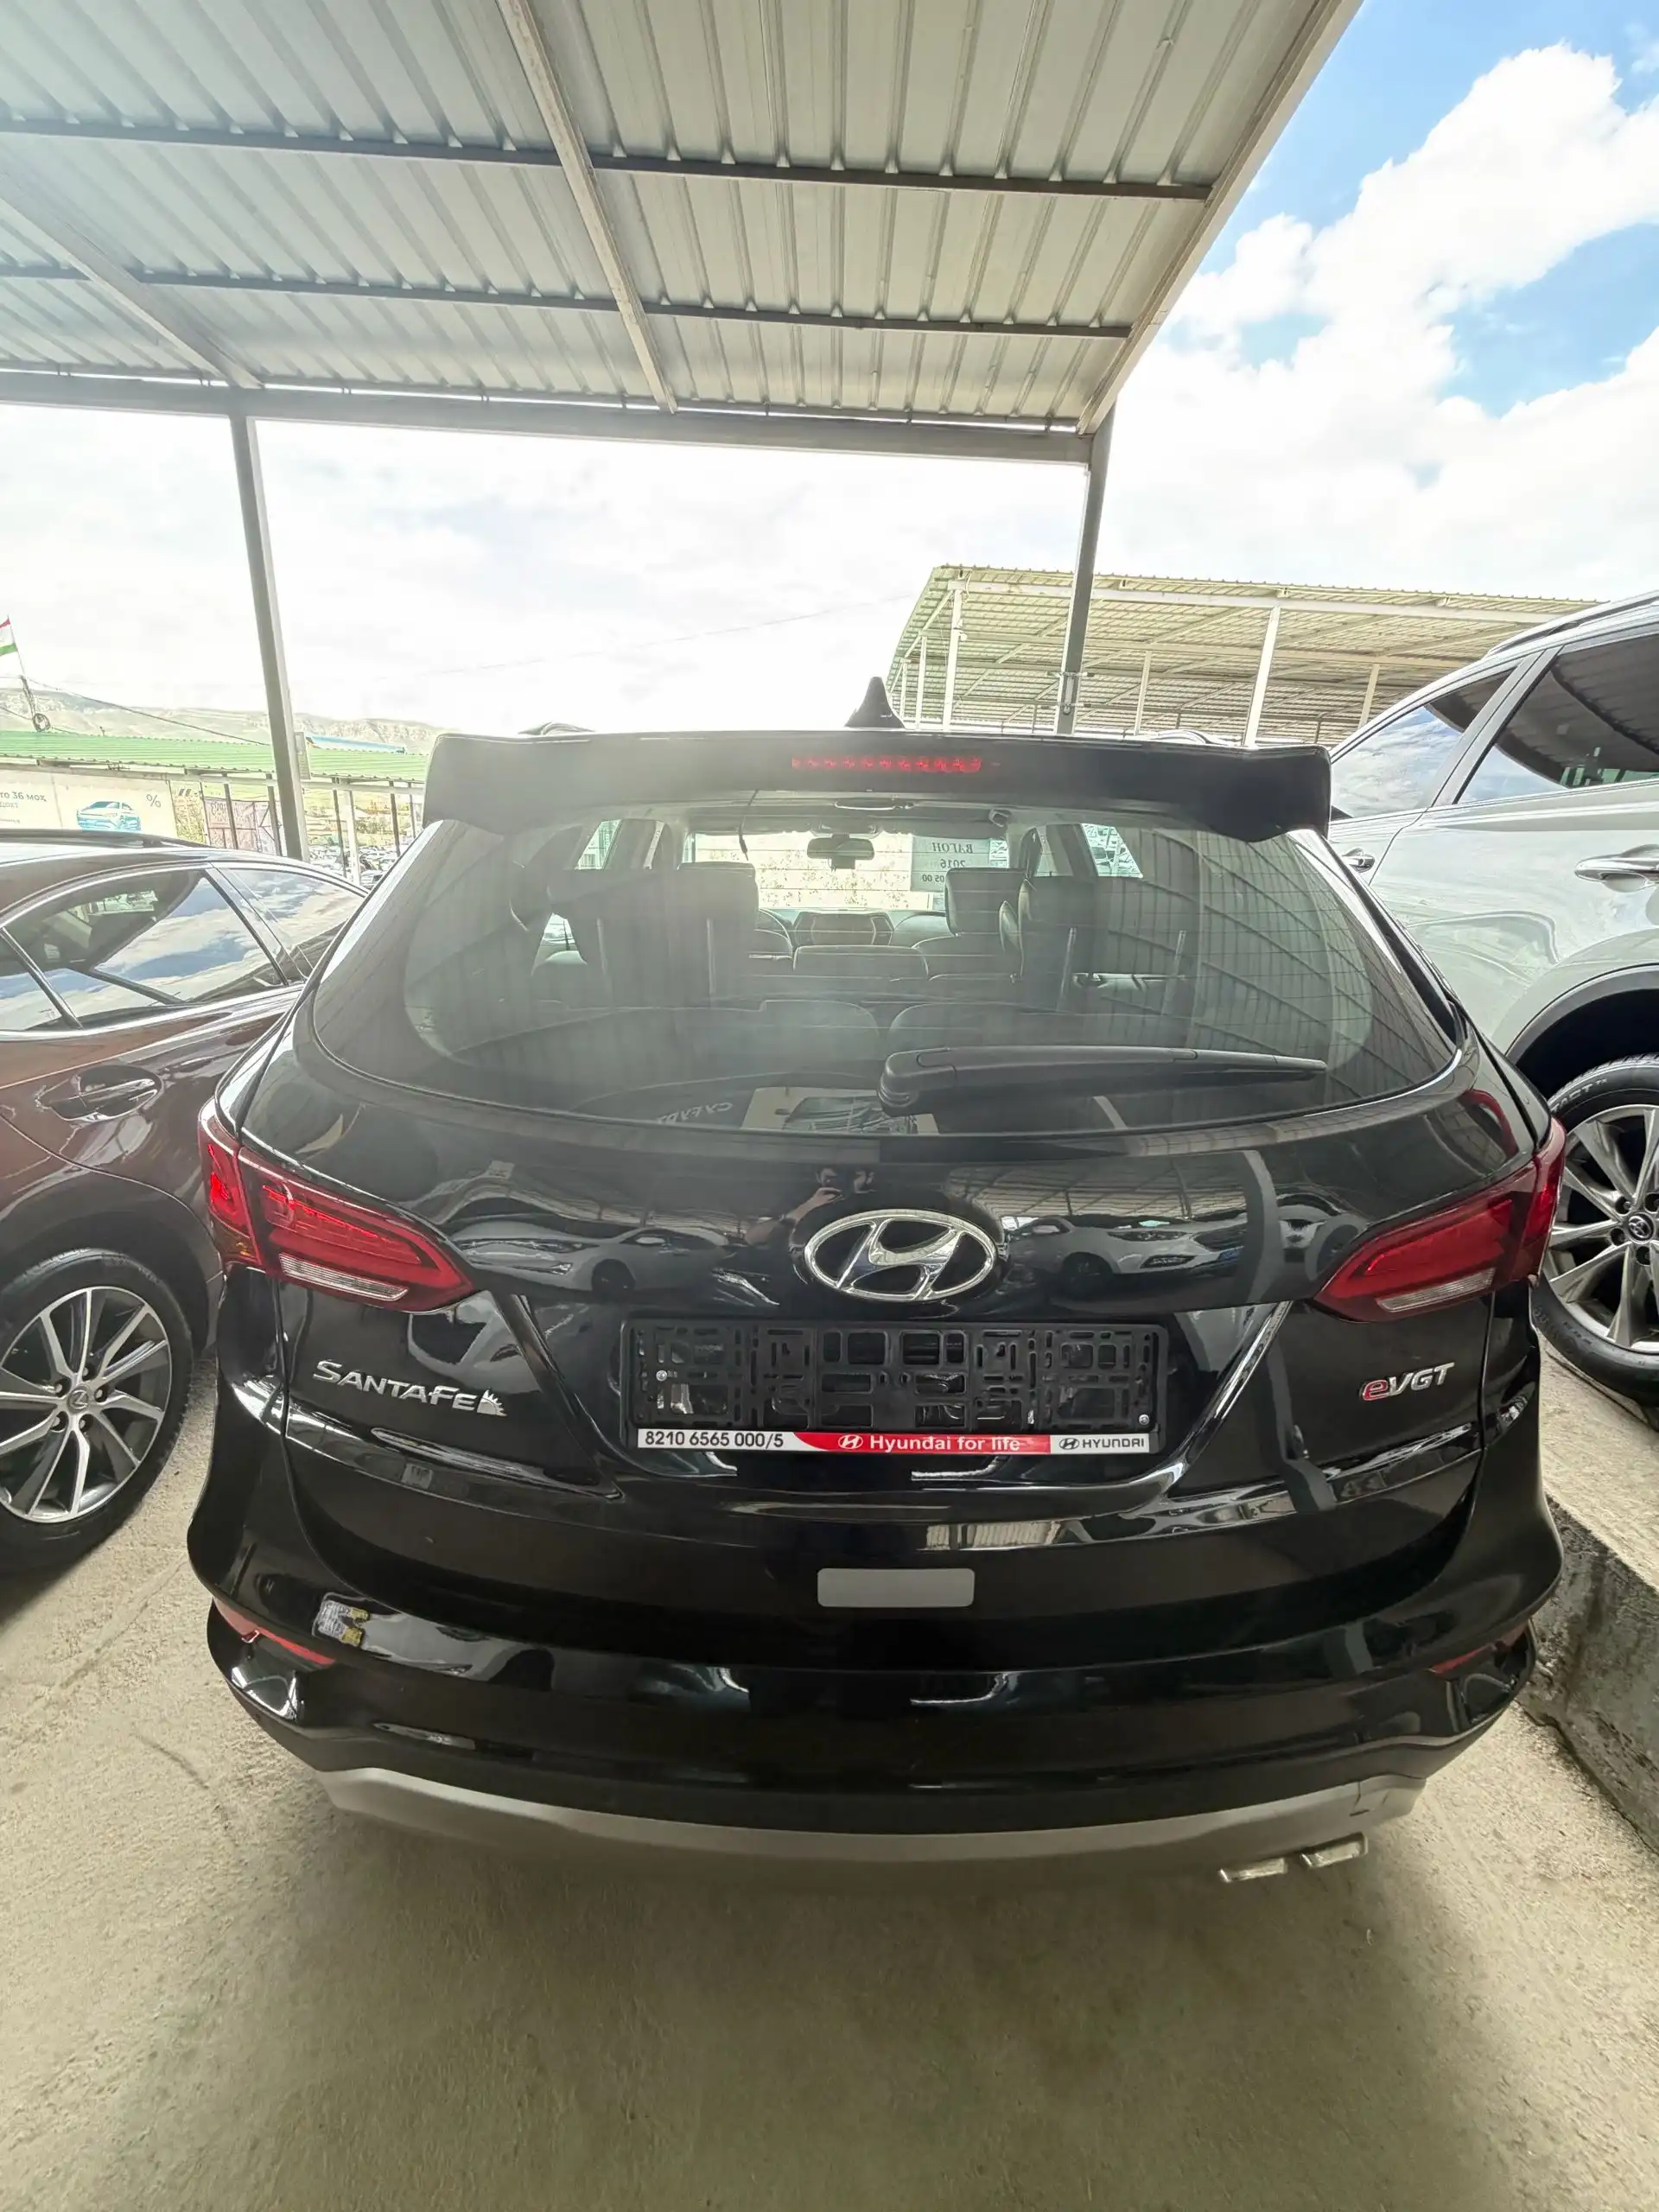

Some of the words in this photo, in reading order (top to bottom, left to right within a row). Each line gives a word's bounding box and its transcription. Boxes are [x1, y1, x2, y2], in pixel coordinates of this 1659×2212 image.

[12, 791, 24, 800] 36
[1362, 1362, 1455, 1401] eVGT
[645, 1431, 685, 1446] 8210
[689, 1432, 730, 1446] 6565
[734, 1433, 784, 1449] 000/5
[870, 1435, 950, 1452] Hyundai
[957, 1436, 983, 1450] for
[991, 1436, 1020, 1451] life
[1082, 1438, 1144, 1448] HYUNDAI
